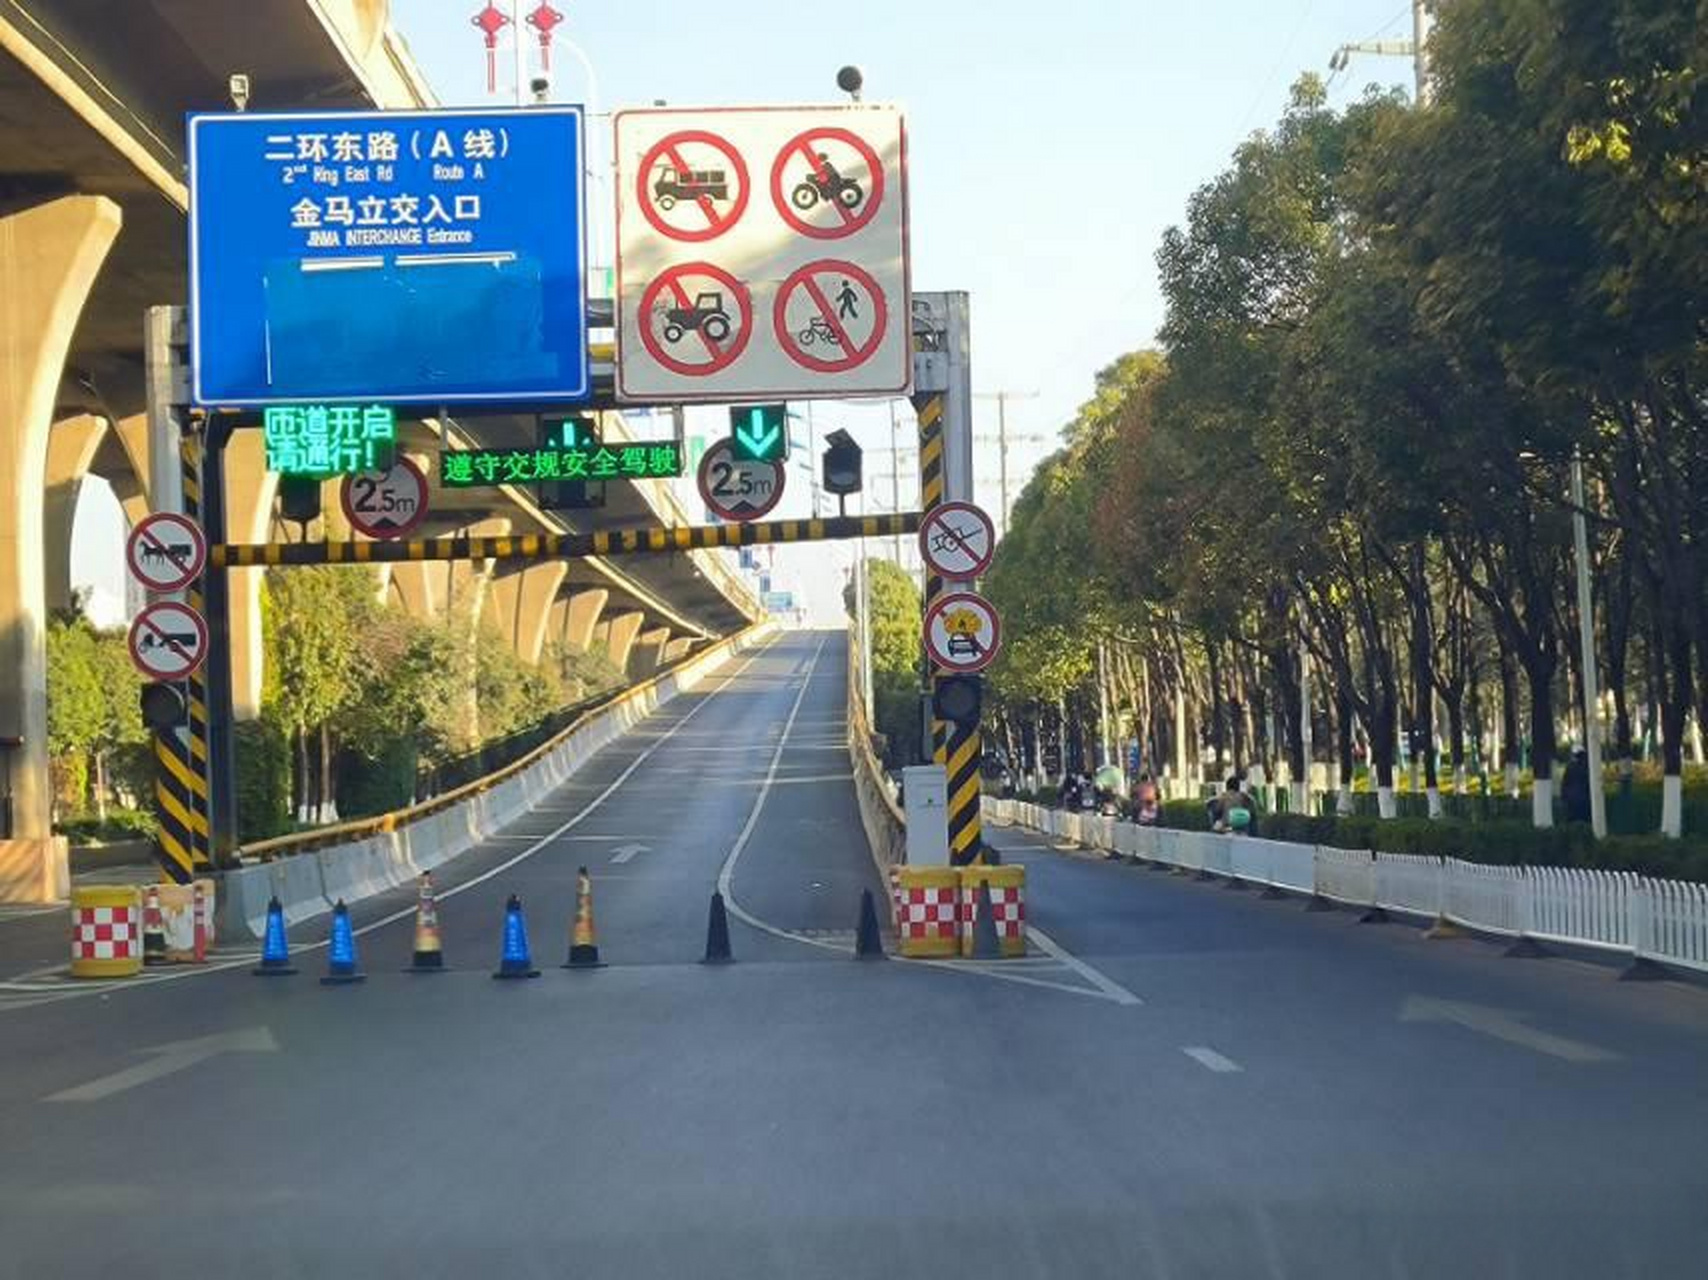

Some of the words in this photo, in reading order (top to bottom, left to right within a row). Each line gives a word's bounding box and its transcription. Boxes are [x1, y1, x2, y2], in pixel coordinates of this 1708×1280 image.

[345, 165, 369, 182] East
[377, 165, 393, 181] Rd
[433, 163, 464, 180] Route
[473, 162, 485, 179] A
[290, 193, 481, 227] 金马立交入口
[346, 227, 422, 246] INTERCHANGE
[427, 226, 473, 243] Entrance
[265, 404, 393, 446] 匝道开启
[444, 444, 677, 482] 遵守交规安全驾驶
[711, 460, 773, 497] 2.5m
[354, 477, 415, 513] 2.5m
